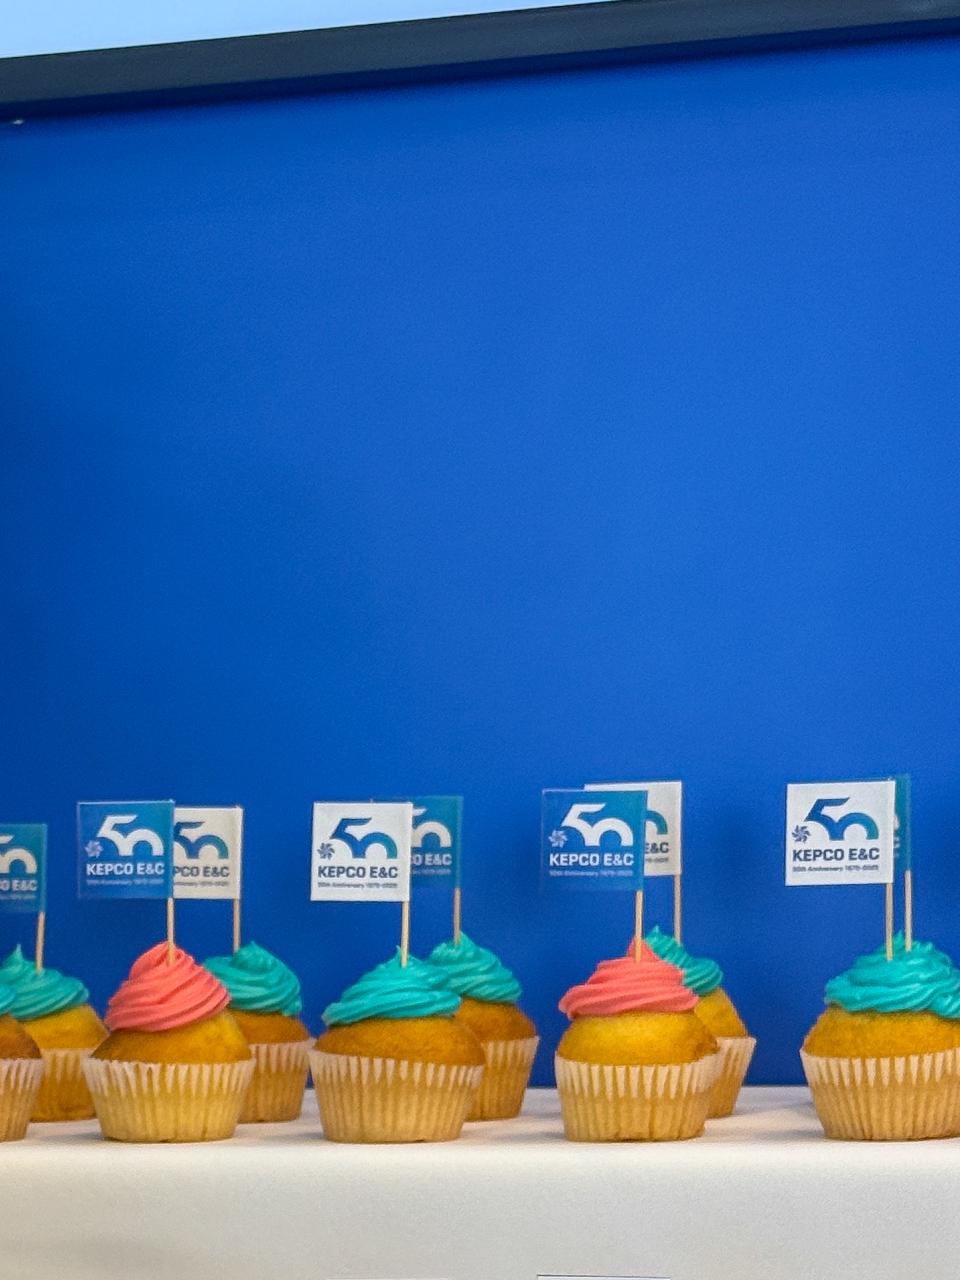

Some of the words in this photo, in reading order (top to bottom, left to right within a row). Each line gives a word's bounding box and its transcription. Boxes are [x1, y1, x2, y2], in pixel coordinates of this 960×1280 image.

[425, 853, 452, 866] E&C
[549, 853, 599, 866] KEPCO
[603, 853, 634, 866] E&C
[792, 849, 844, 861] KEPCO
[849, 848, 880, 860] E&C
[86, 863, 133, 875] KEPCO
[137, 863, 165, 875] E&C
[174, 866, 199, 877] PCO
[202, 866, 230, 877] E&C
[318, 866, 366, 878] KEPCO
[369, 866, 398, 878] E&C
